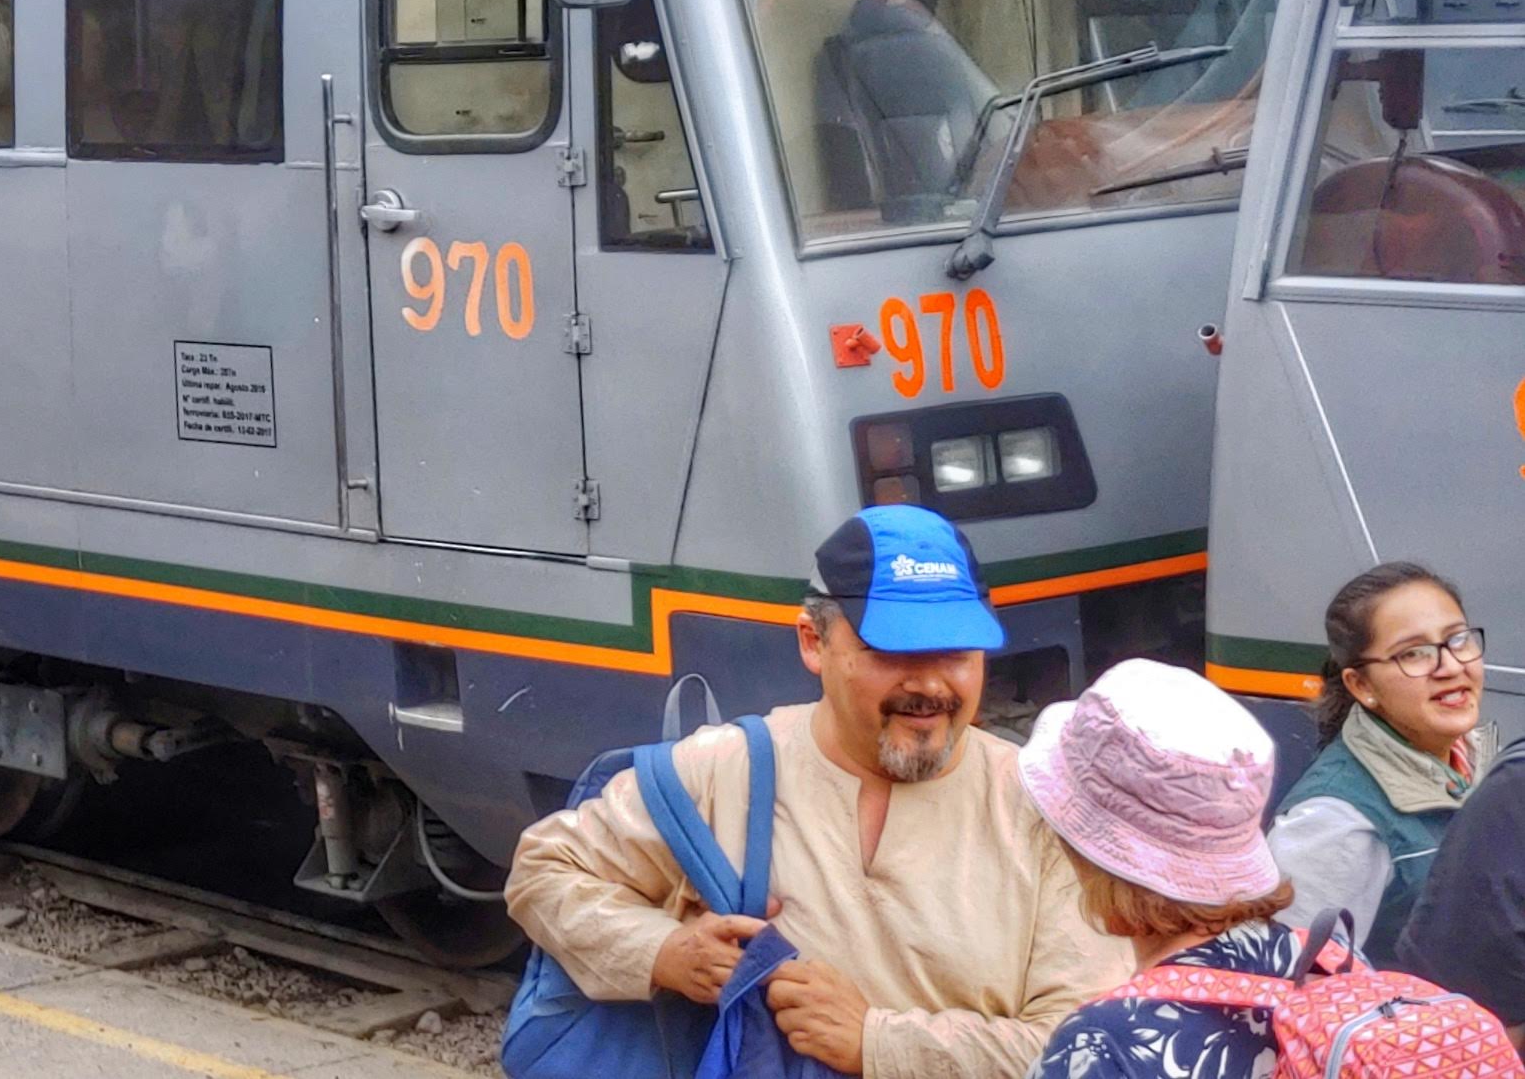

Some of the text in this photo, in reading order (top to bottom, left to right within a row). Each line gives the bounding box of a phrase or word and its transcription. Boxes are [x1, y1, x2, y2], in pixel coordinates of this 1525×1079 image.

[400, 236, 536, 340] 970
[226, 382, 249, 393] Agosto
[879, 286, 1005, 398] 970
